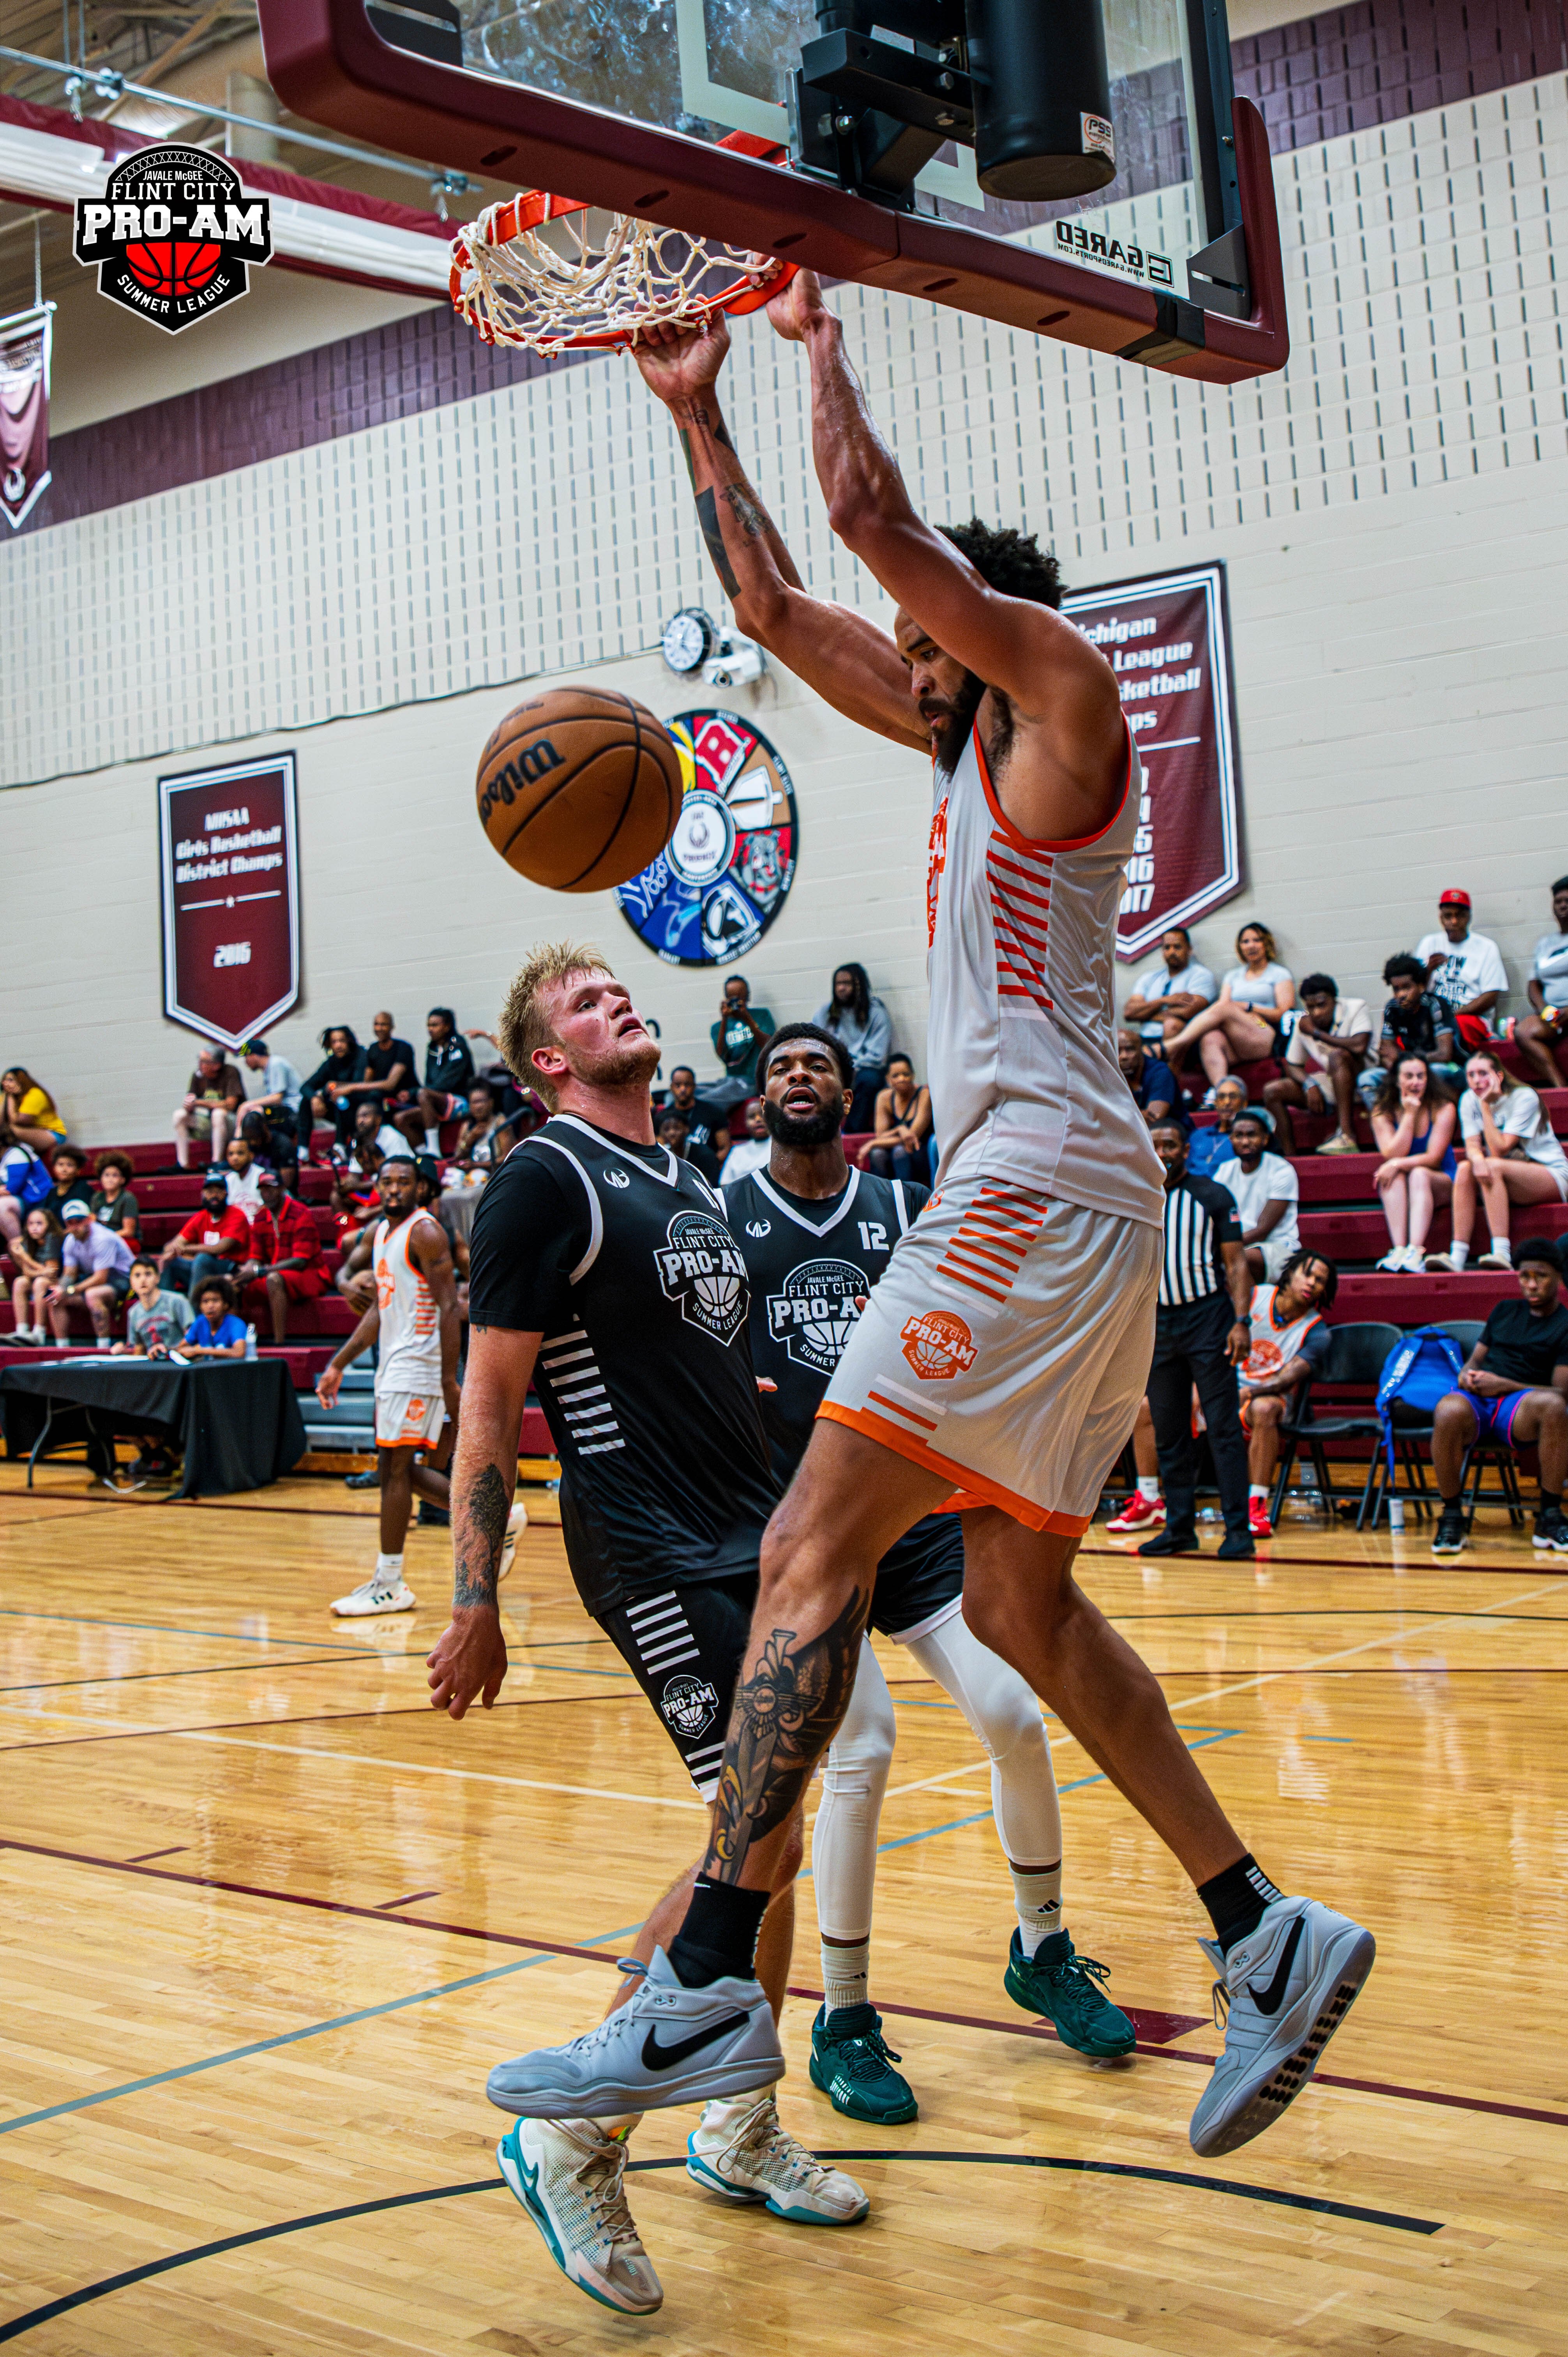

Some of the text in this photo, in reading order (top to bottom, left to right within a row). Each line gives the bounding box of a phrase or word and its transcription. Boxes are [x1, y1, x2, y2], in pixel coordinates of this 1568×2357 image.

[1113, 641, 1193, 672] League
[176, 852, 283, 883] District Champs
[673, 1235, 733, 1249] FLINT CITY
[858, 1222, 890, 1251] 12
[789, 1281, 864, 1297] FLINT CITY
[692, 1300, 743, 1330] SUMMER LEAGUE
[773, 1295, 867, 1329] PRO-A
[904, 1319, 975, 1366] PRO-AM
[923, 1317, 949, 1333] FLINT
[949, 1328, 969, 1344] CITY
[800, 1344, 835, 1367] SUMMER
[663, 1687, 715, 1718] PRO-AM
[666, 1689, 682, 1701] FLINT
[684, 1683, 699, 1694] CITY
